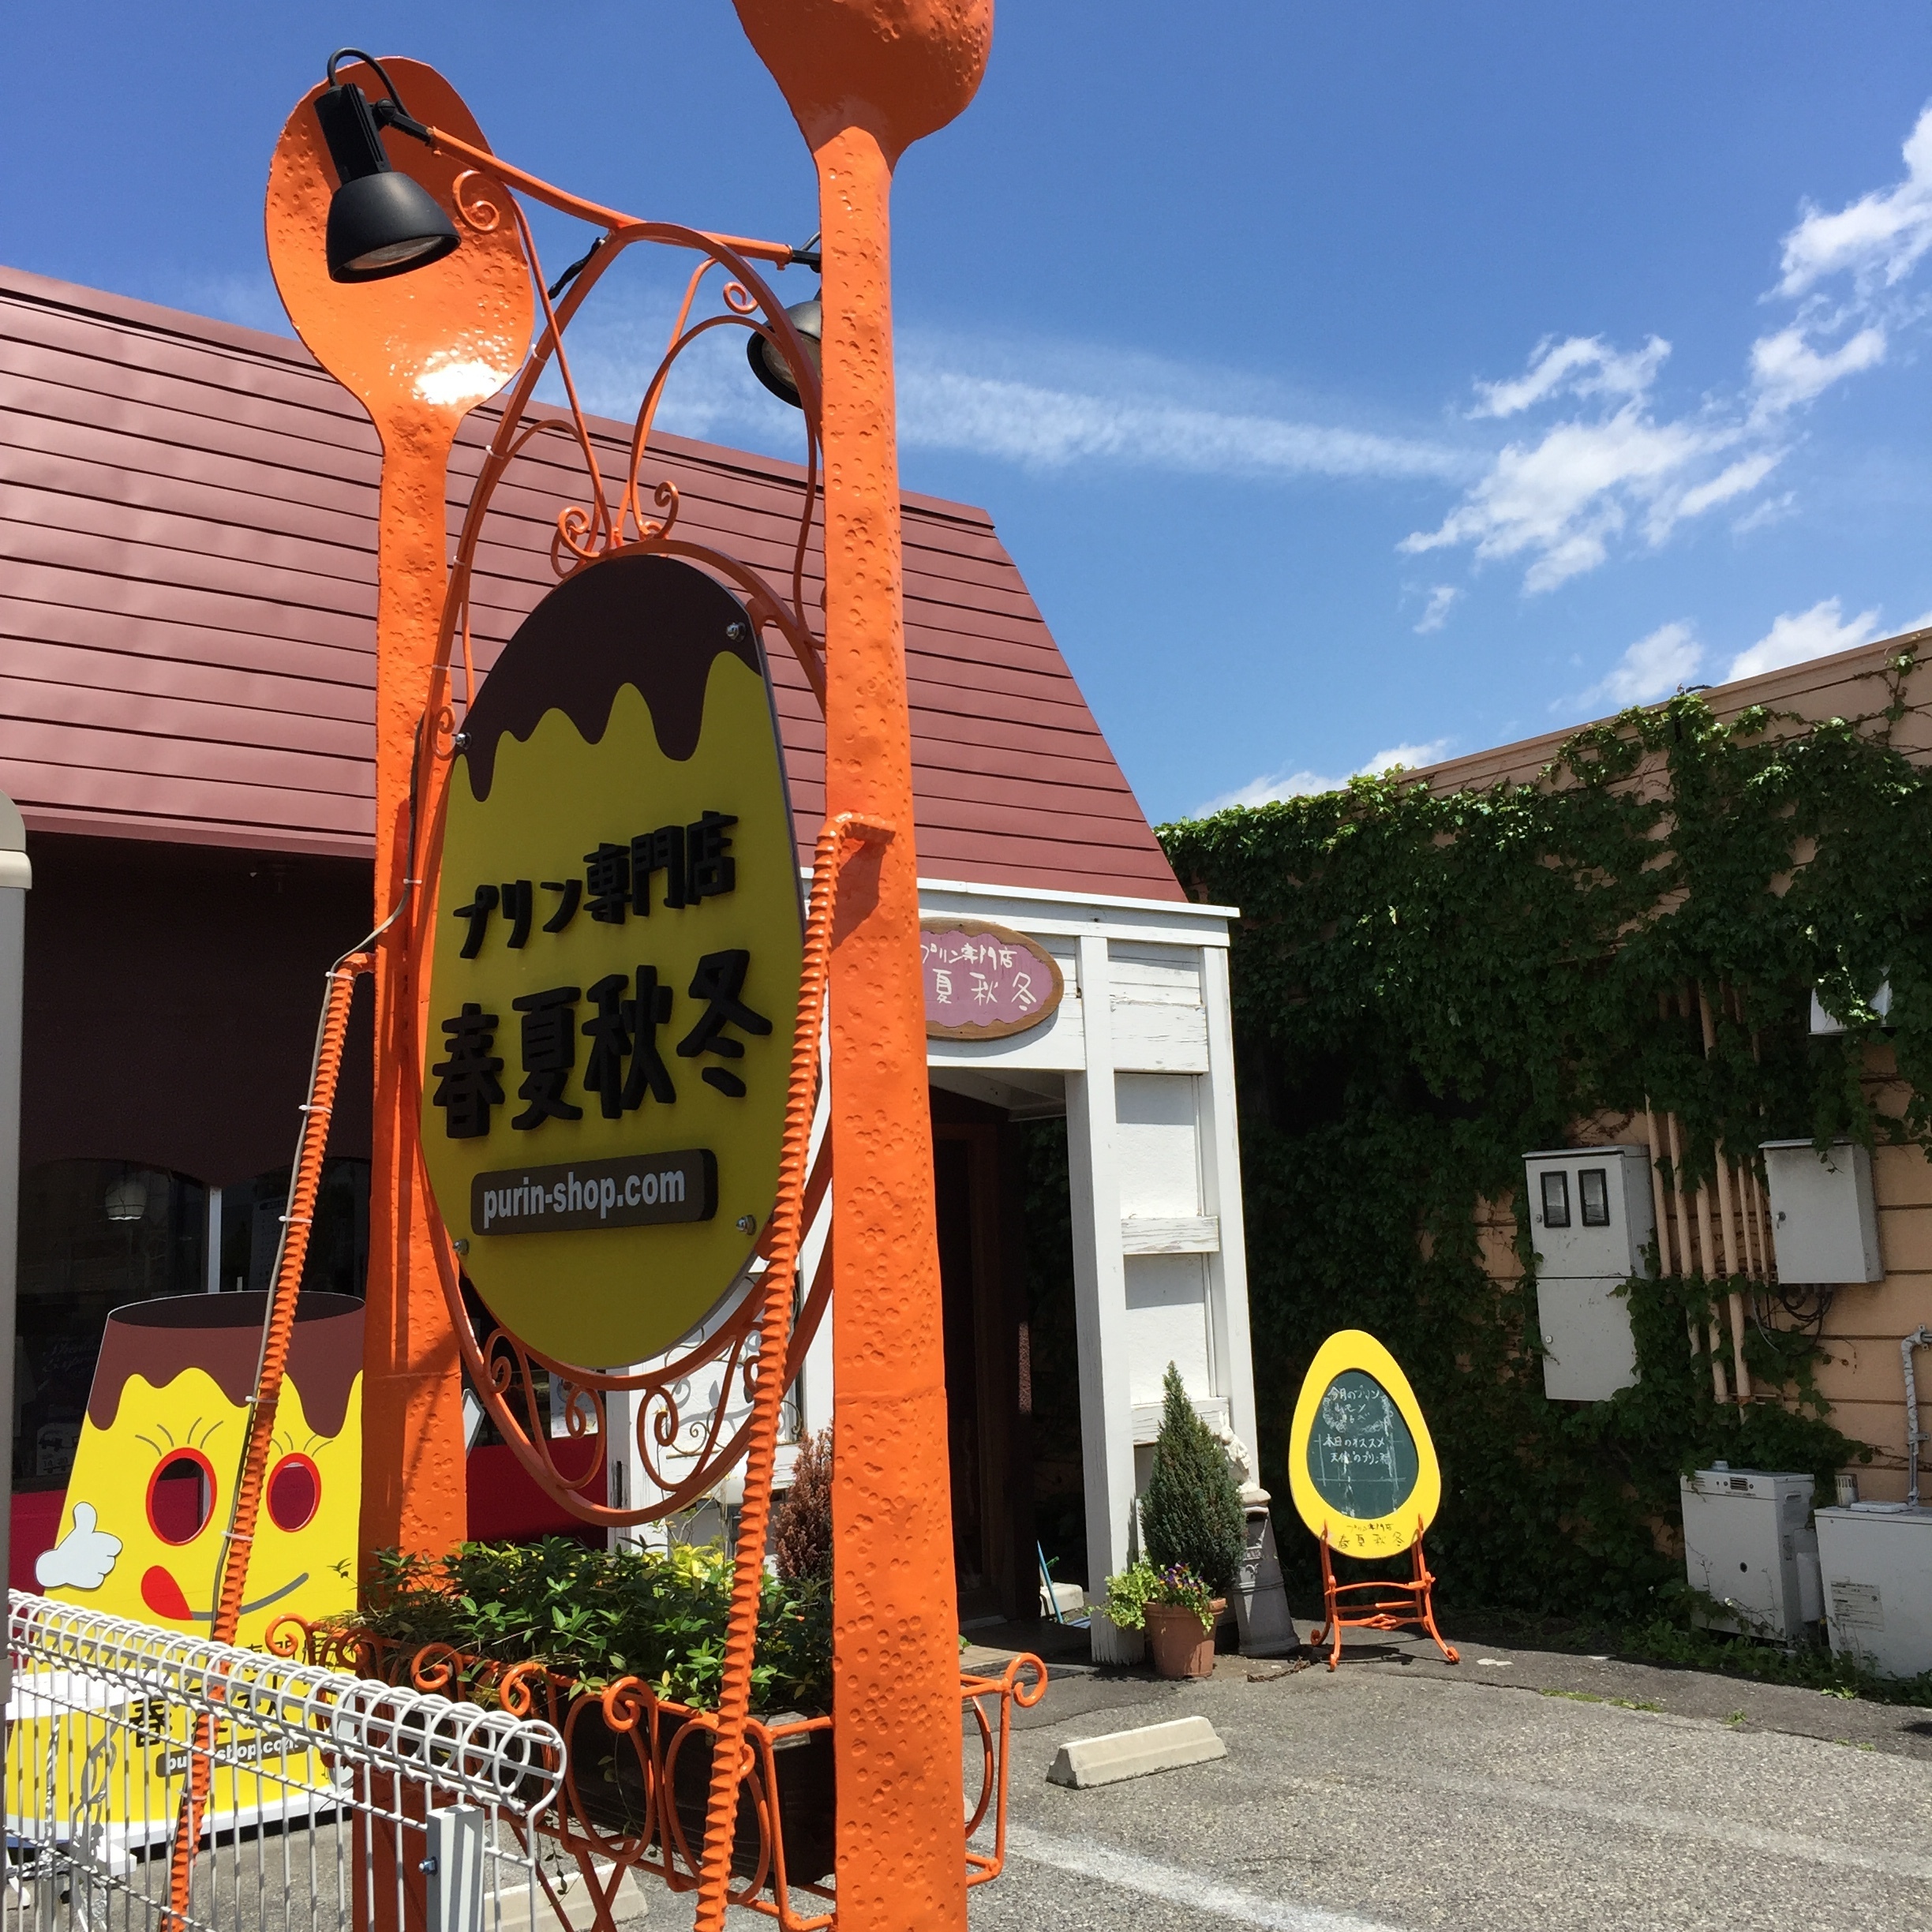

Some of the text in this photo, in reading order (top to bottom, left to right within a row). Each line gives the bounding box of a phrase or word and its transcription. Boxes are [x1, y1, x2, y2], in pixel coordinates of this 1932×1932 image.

[453, 810, 739, 960] プリン専門店
[432, 949, 773, 1139] 春夏秋冬
[482, 1168, 686, 1229] purin-shop.com
[1323, 1433, 1385, 1448] 本日のオススメ
